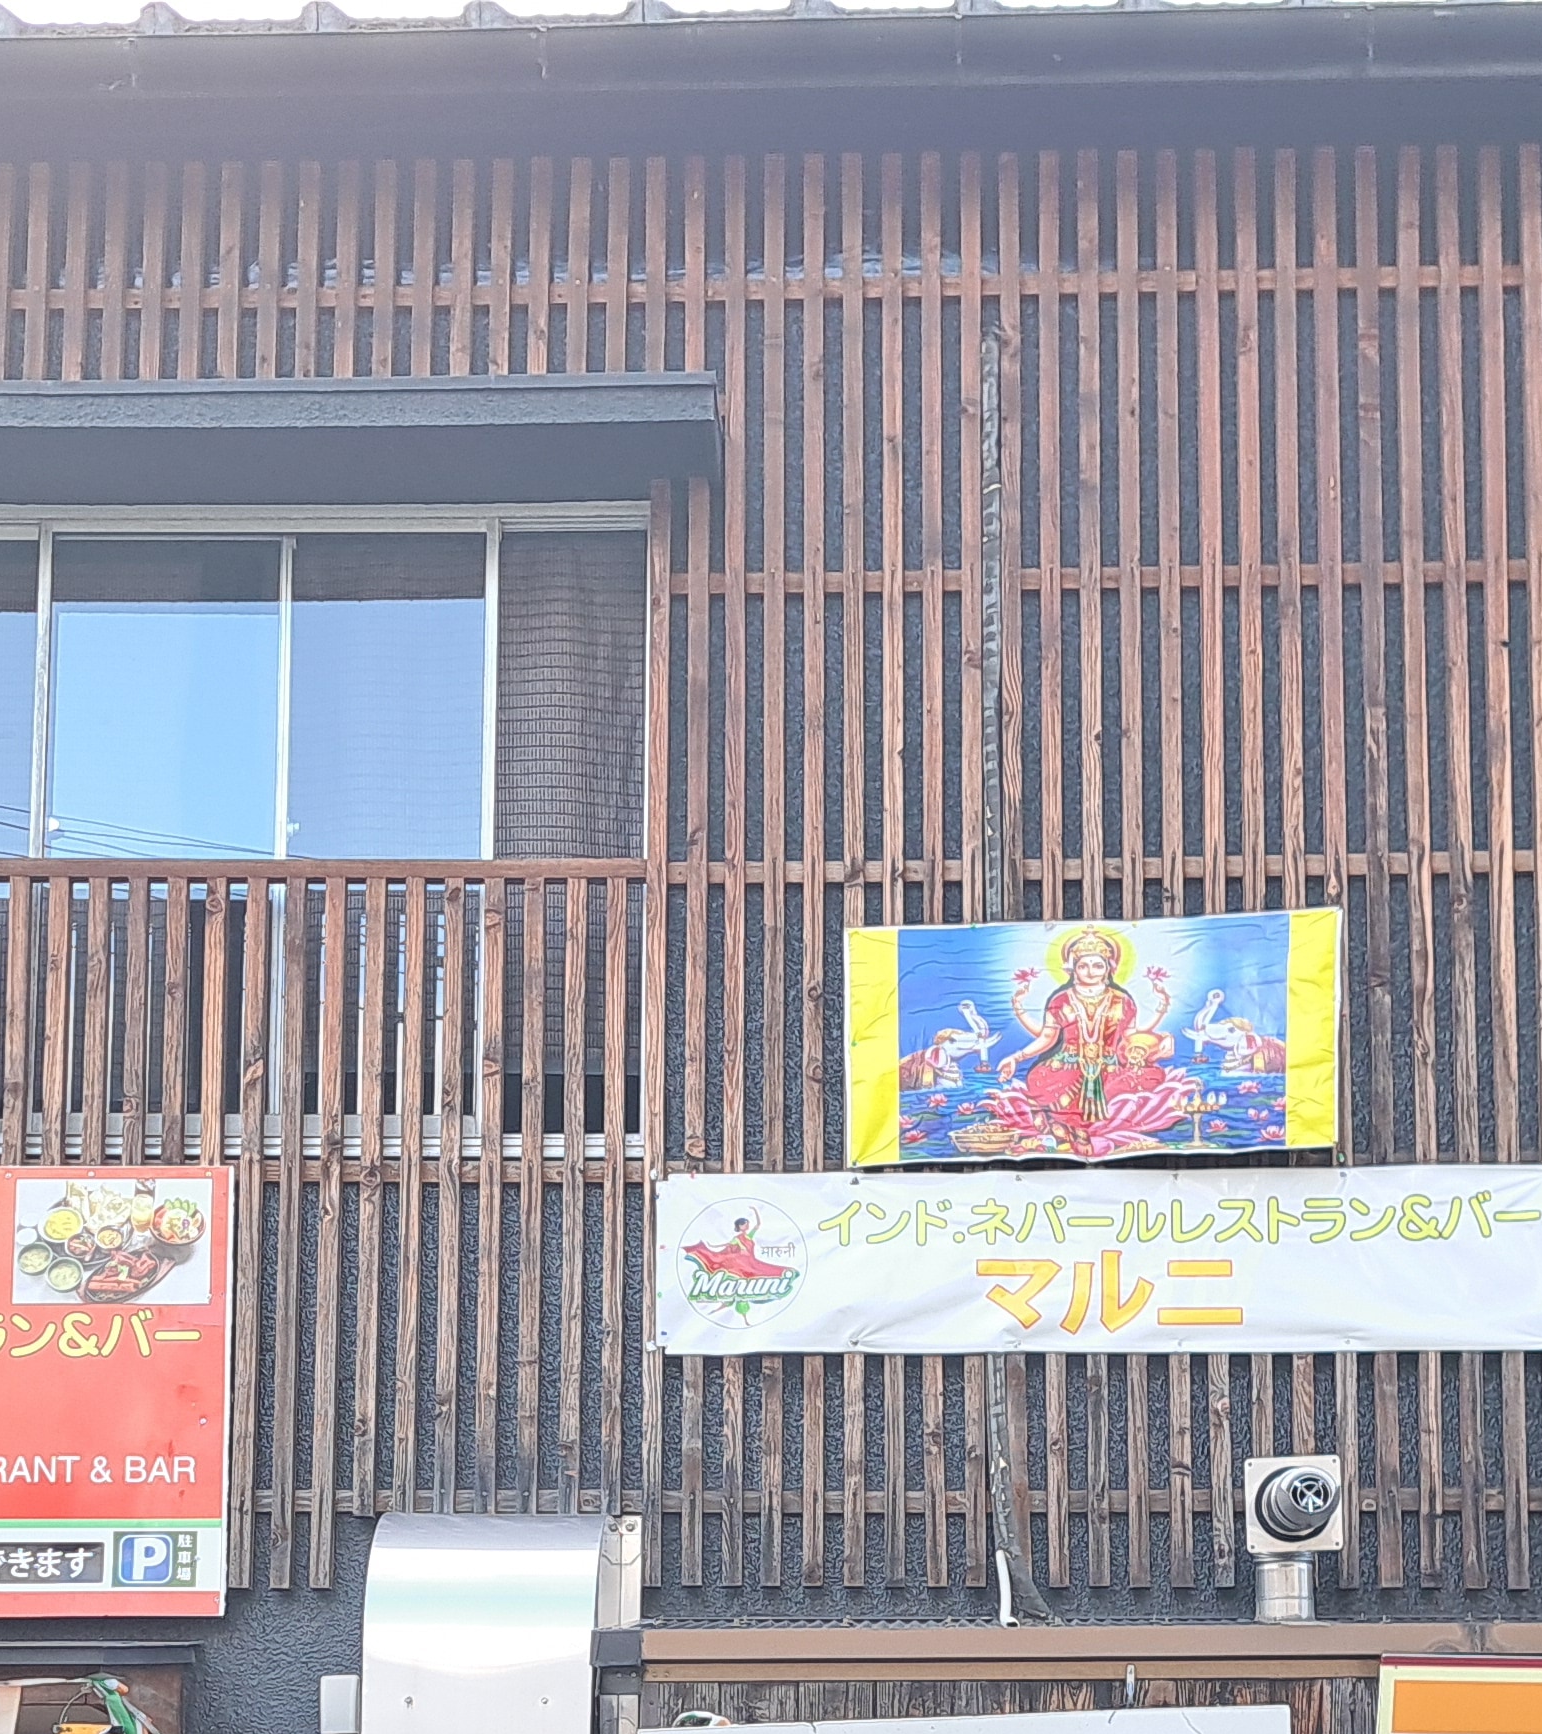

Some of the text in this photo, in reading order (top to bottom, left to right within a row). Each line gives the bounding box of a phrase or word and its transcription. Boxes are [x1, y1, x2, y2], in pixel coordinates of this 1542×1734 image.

[690, 1269, 793, 1298] Maruni
[975, 1248, 1244, 1336] マルニ
[89, 1455, 113, 1484] &
[124, 1454, 197, 1484] BAR
[129, 1537, 169, 1582] P
